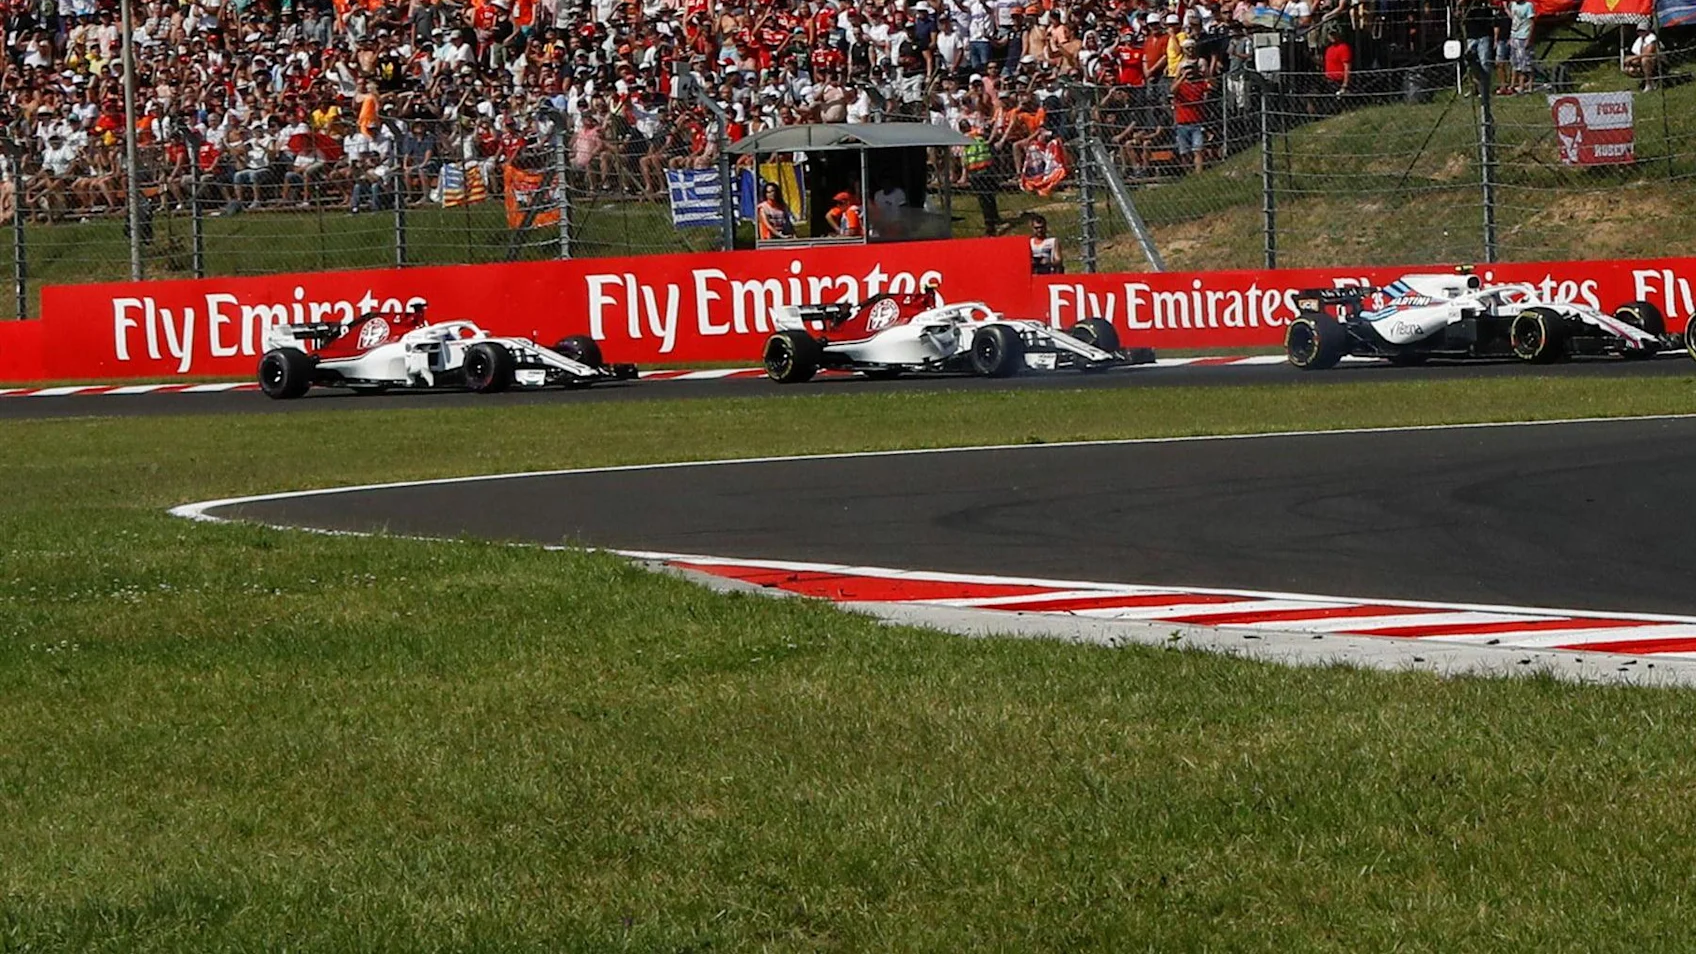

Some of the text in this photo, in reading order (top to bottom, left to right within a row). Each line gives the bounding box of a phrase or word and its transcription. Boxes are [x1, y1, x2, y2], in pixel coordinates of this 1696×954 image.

[1597, 102, 1628, 115] FORZA
[586, 272, 678, 354] Fly
[1048, 283, 1117, 330] Fly
[1125, 278, 1303, 330] Emirates
[1371, 292, 1385, 311] 35
[113, 297, 195, 374] Fly
